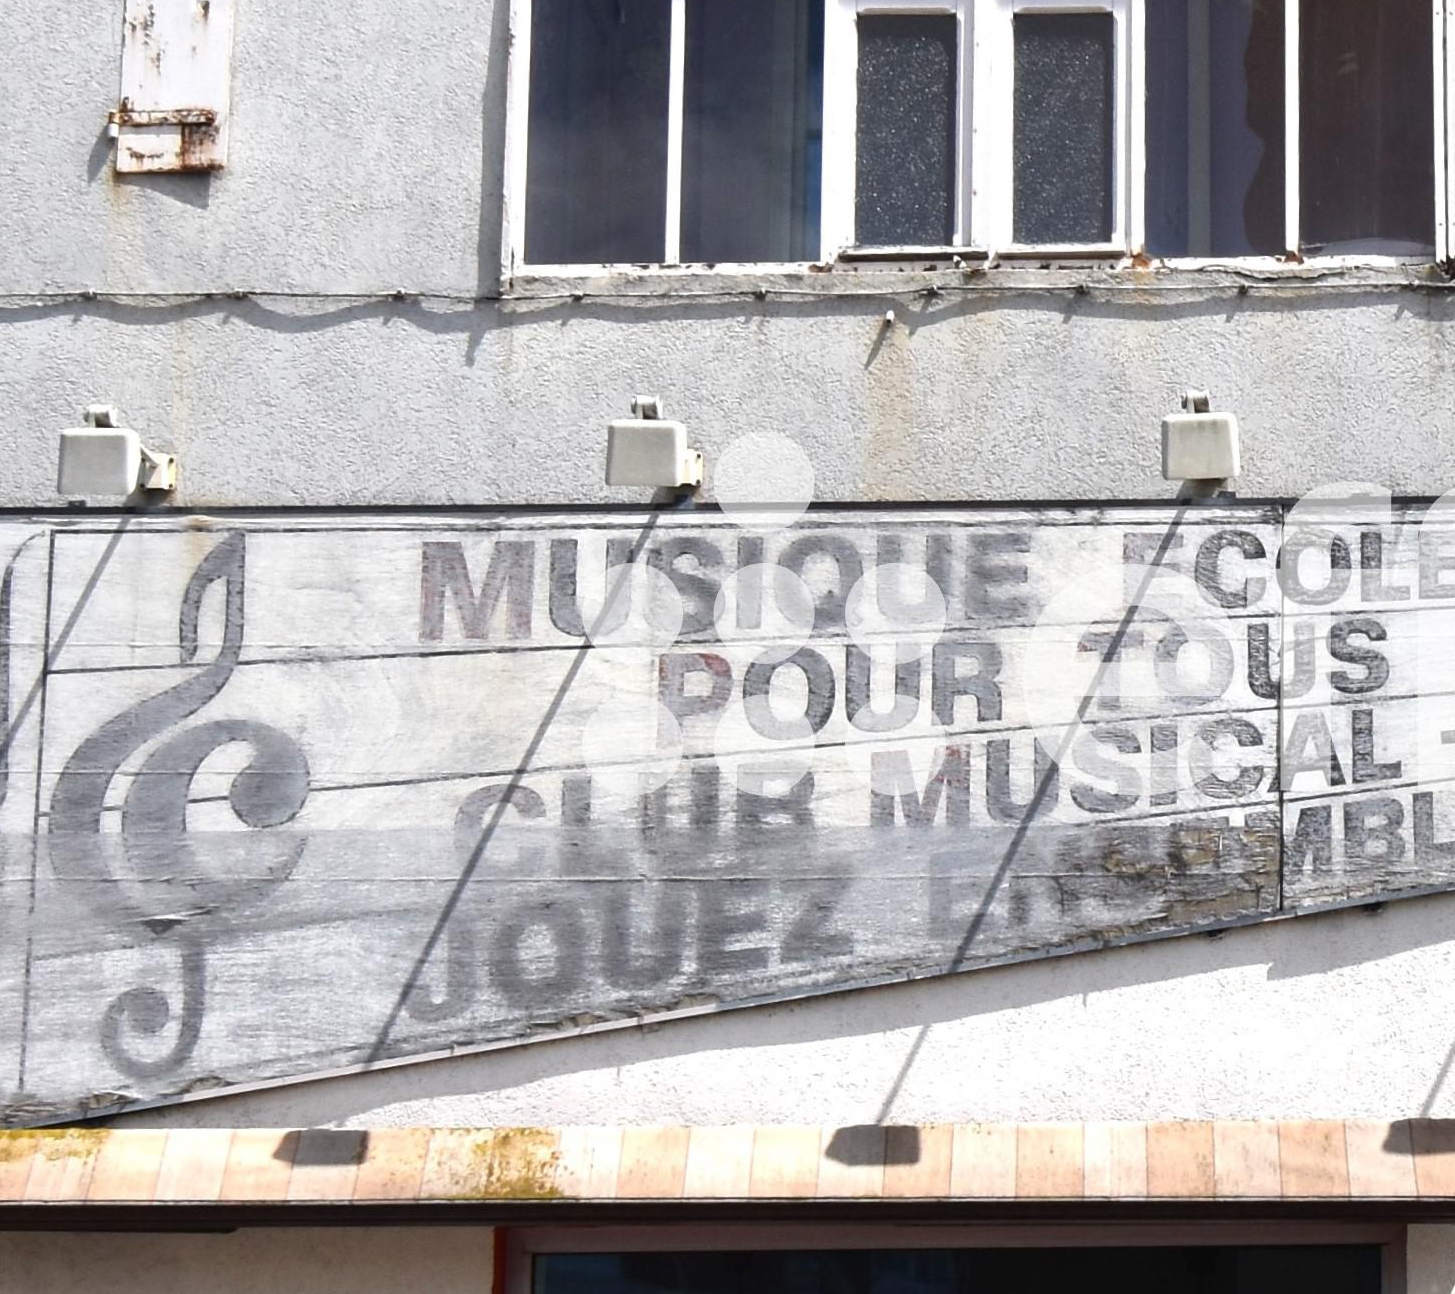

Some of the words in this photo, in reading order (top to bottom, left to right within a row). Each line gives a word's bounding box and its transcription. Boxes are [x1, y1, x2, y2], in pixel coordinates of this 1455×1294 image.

[418, 533, 1031, 642] MUSIQUE
[657, 641, 1003, 749] POUR
[1077, 618, 1390, 710] TOUS
[454, 763, 815, 879] CLUB
[870, 709, 1403, 828] MUSICAL
[408, 857, 855, 1021] JOUEZ
